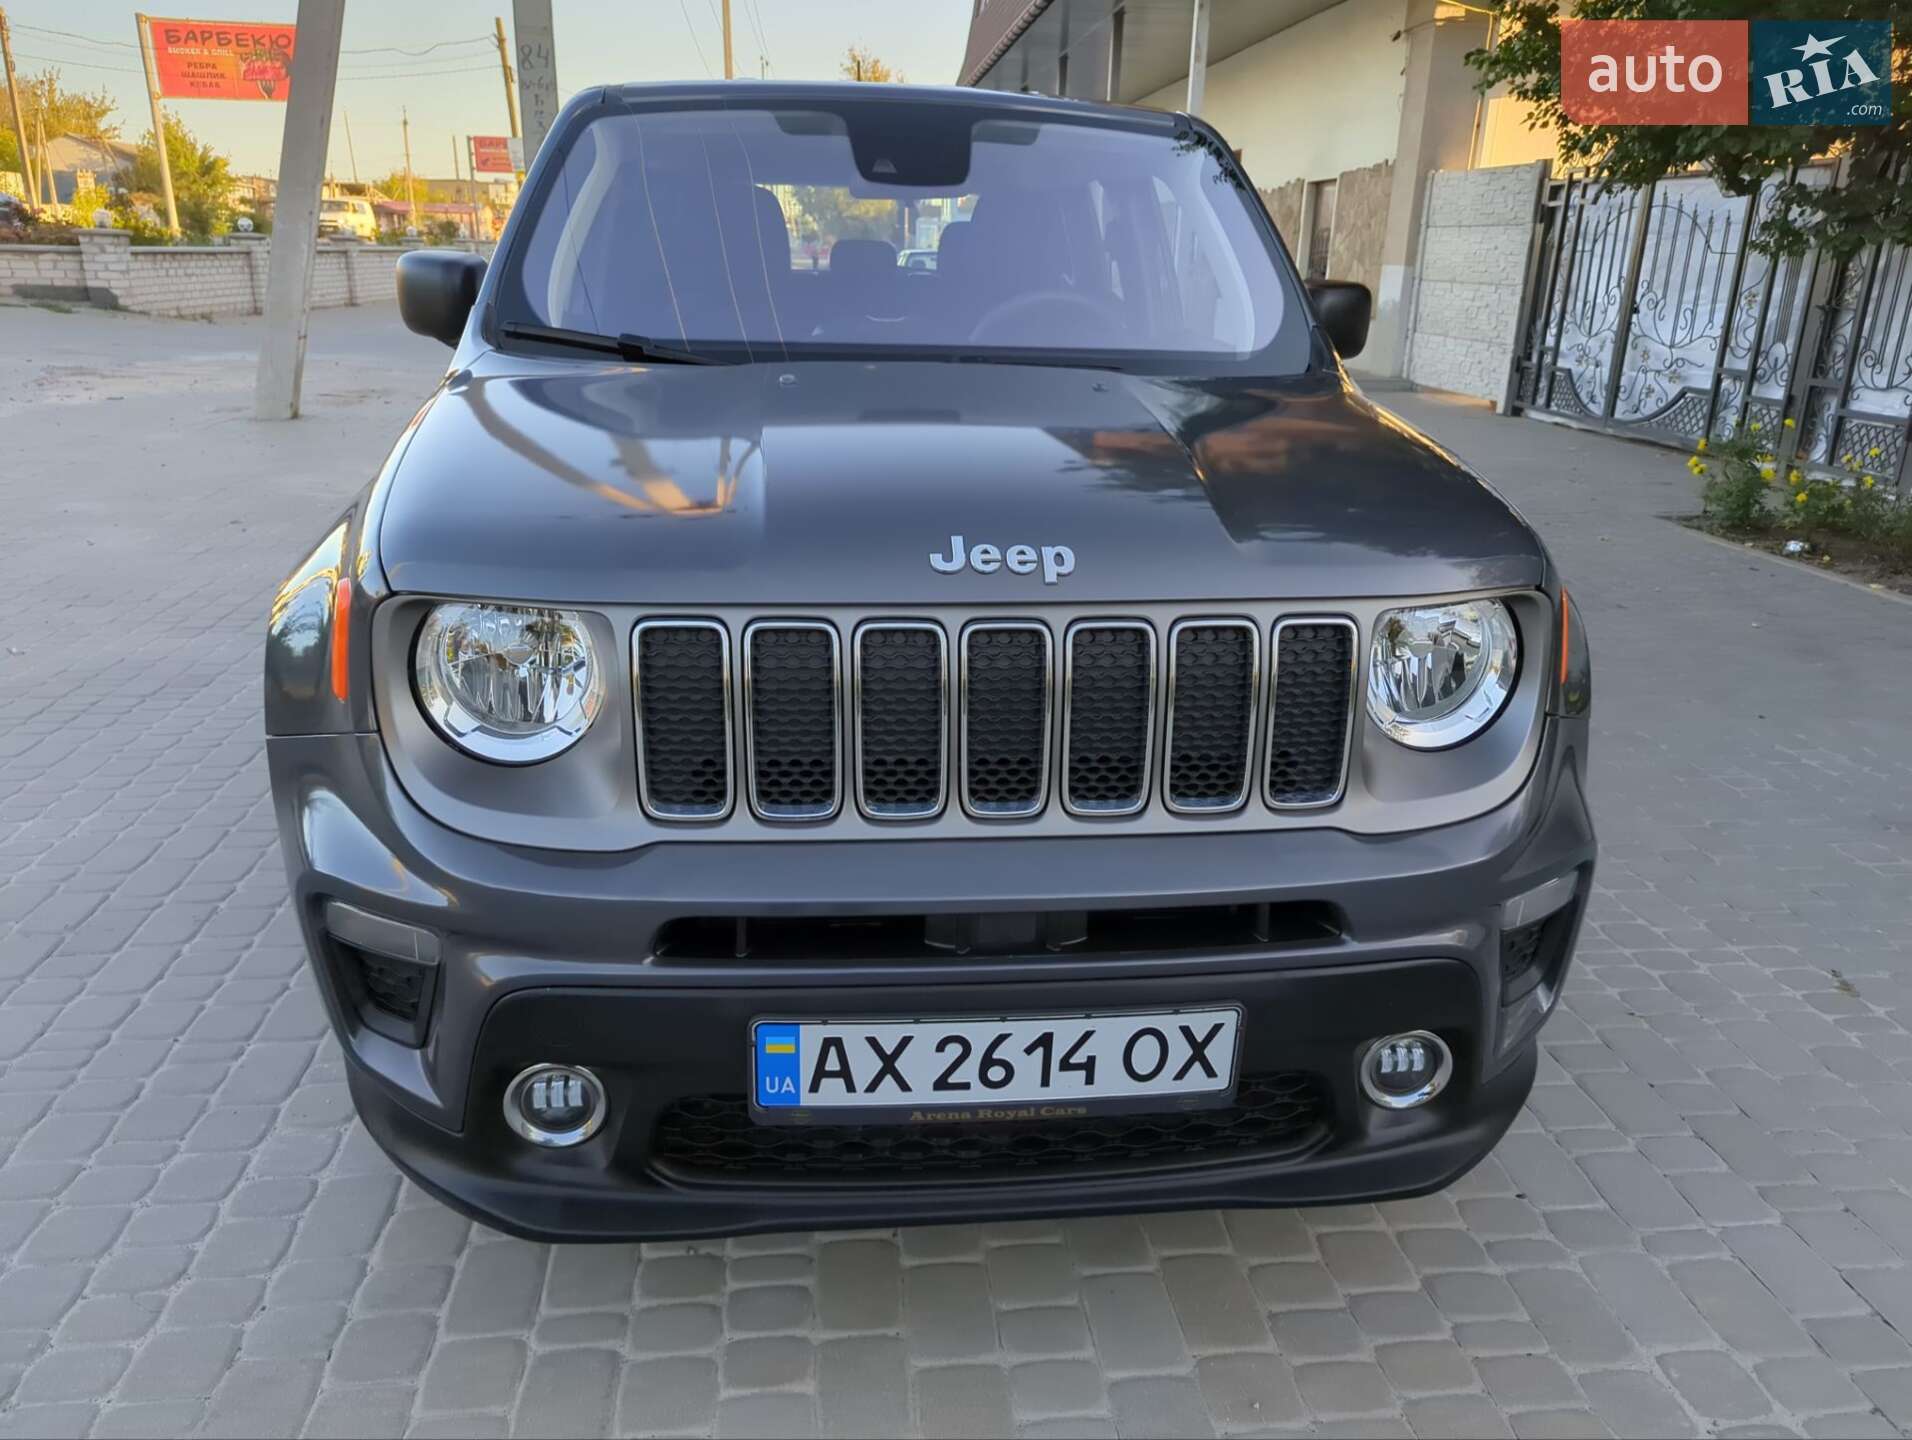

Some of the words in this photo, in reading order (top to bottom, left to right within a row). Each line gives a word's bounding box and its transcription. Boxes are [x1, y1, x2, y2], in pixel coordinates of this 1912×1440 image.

[164, 29, 292, 49] БАРБЕКЮ
[929, 535, 1076, 585] Jeep
[808, 1034, 914, 1094] AX
[933, 1029, 1097, 1092] 2614
[1122, 1022, 1225, 1082] OX
[765, 1076, 796, 1094] UA
[910, 1110, 971, 1121] Arena
[976, 1107, 1035, 1120] Royal
[1040, 1106, 1087, 1116] Cars
